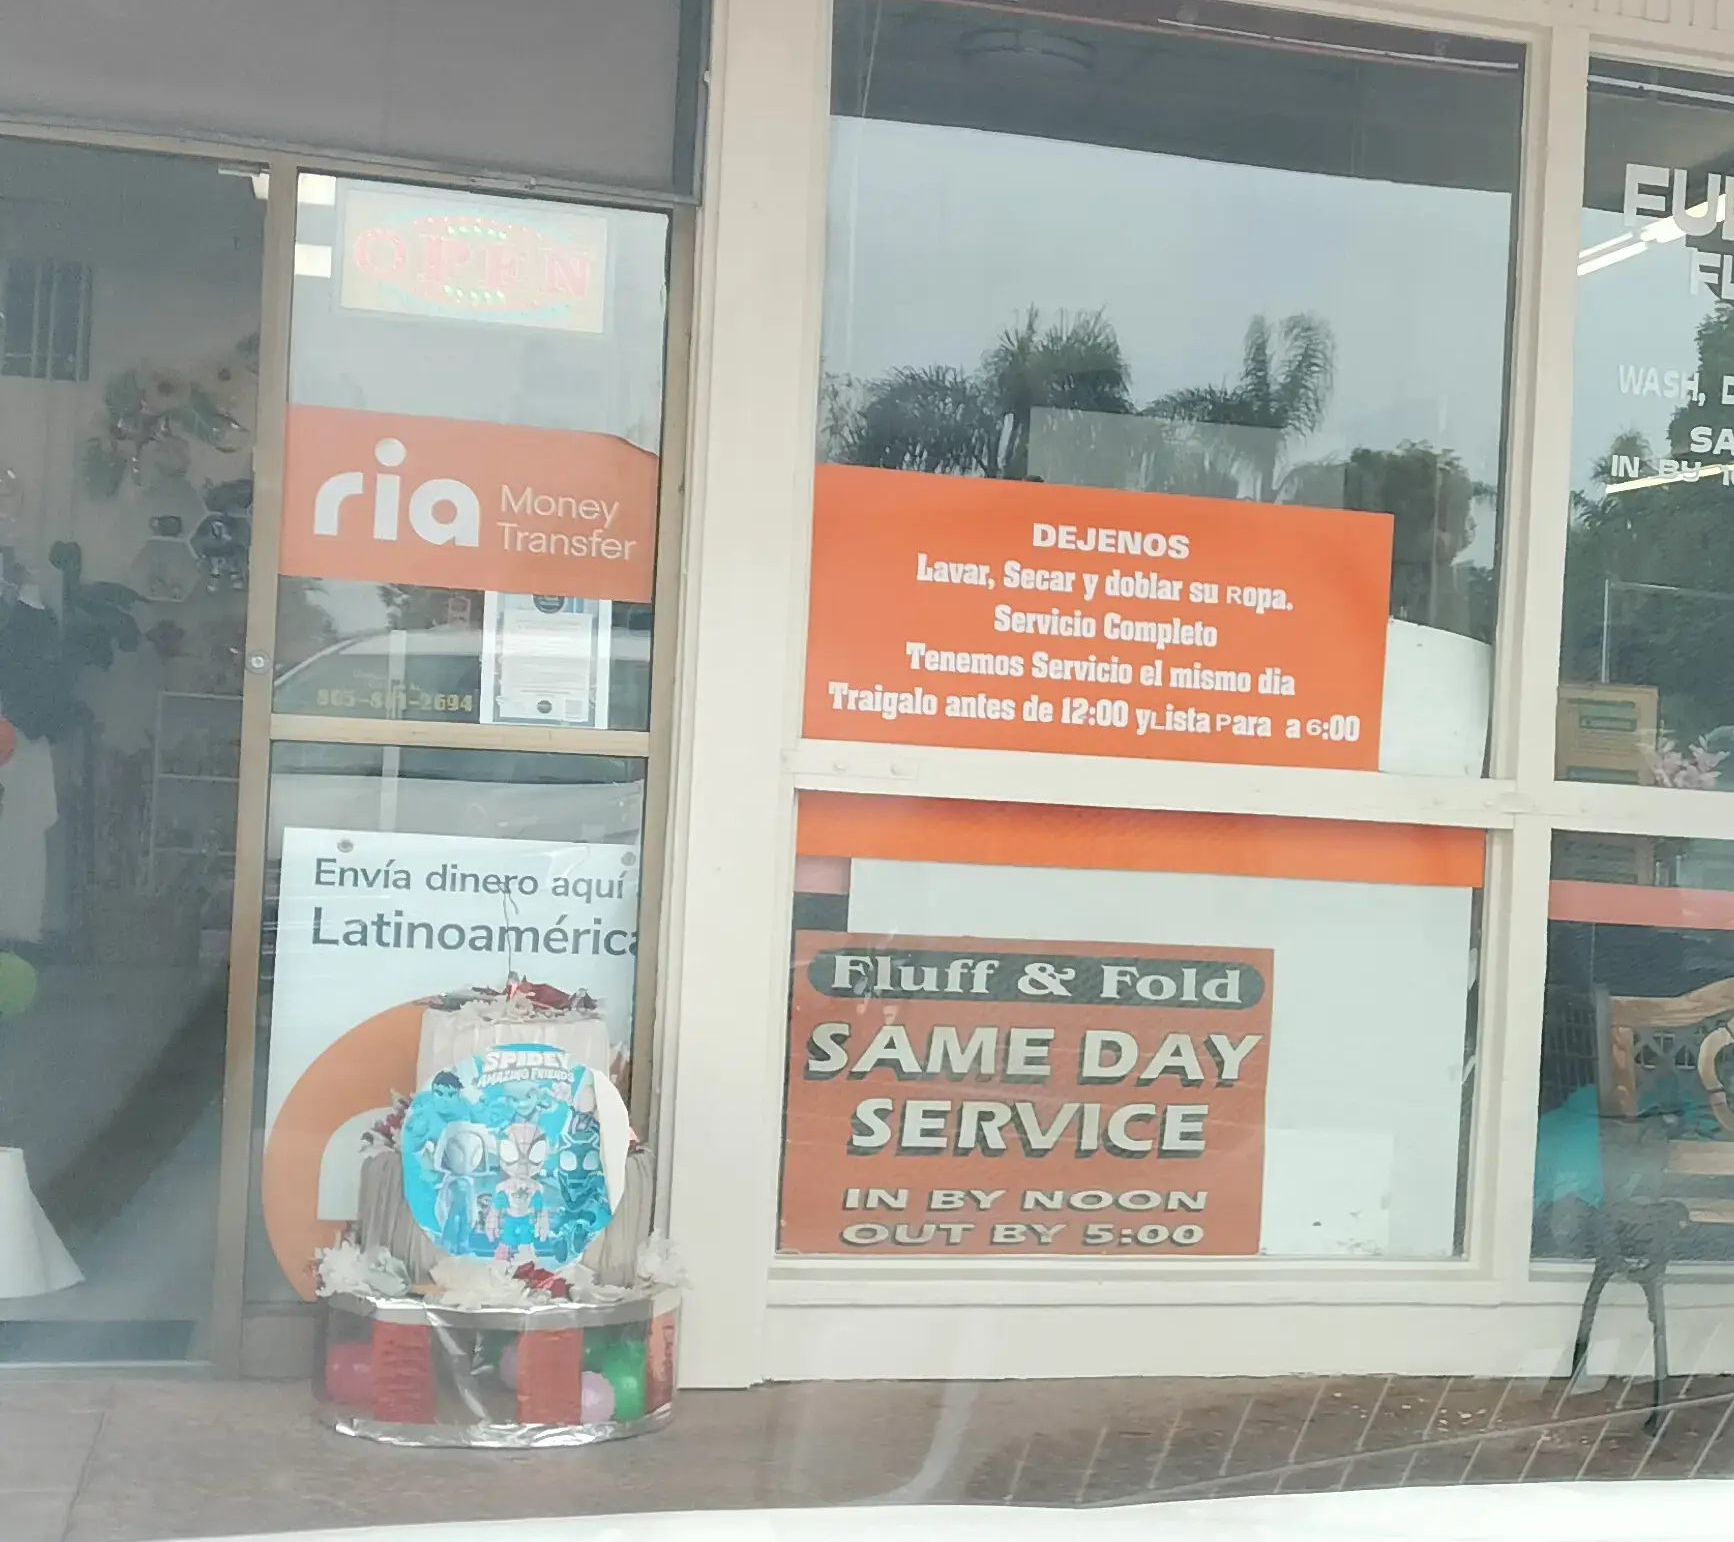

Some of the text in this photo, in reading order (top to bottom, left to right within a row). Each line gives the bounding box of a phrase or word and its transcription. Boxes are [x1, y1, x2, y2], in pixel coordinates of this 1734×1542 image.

[352, 225, 592, 298] OPEN
[1618, 364, 1706, 407] WASH,
[1611, 454, 1640, 478] IN
[313, 437, 481, 548] ria
[499, 483, 619, 526] Money
[497, 523, 637, 561] Transfer
[1033, 523, 1190, 559] DEJENOS
[917, 553, 1294, 614] Lavar, Secar y doblar su Ropa.
[994, 604, 1218, 650] Servicio Completo
[906, 641, 1295, 696] Tenemos Servicio el mismo dia
[829, 681, 938, 720] Traigalo
[945, 693, 1016, 720] antes
[1023, 695, 1053, 723] de
[1061, 698, 1129, 728] 12:00
[1216, 713, 1272, 737] Para
[1285, 718, 1301, 739] a
[1306, 714, 1360, 742] 6:00
[314, 858, 629, 904] Envía dinero aquí
[831, 954, 1243, 1004] Fluff & Fold
[483, 1051, 571, 1072] SPIDEY
[804, 1022, 1264, 1082] SAME DAY
[850, 1097, 1210, 1153] SERVICE
[843, 1187, 1208, 1211] IN BY NOON
[841, 1223, 1204, 1247] OUT BY 5:00
